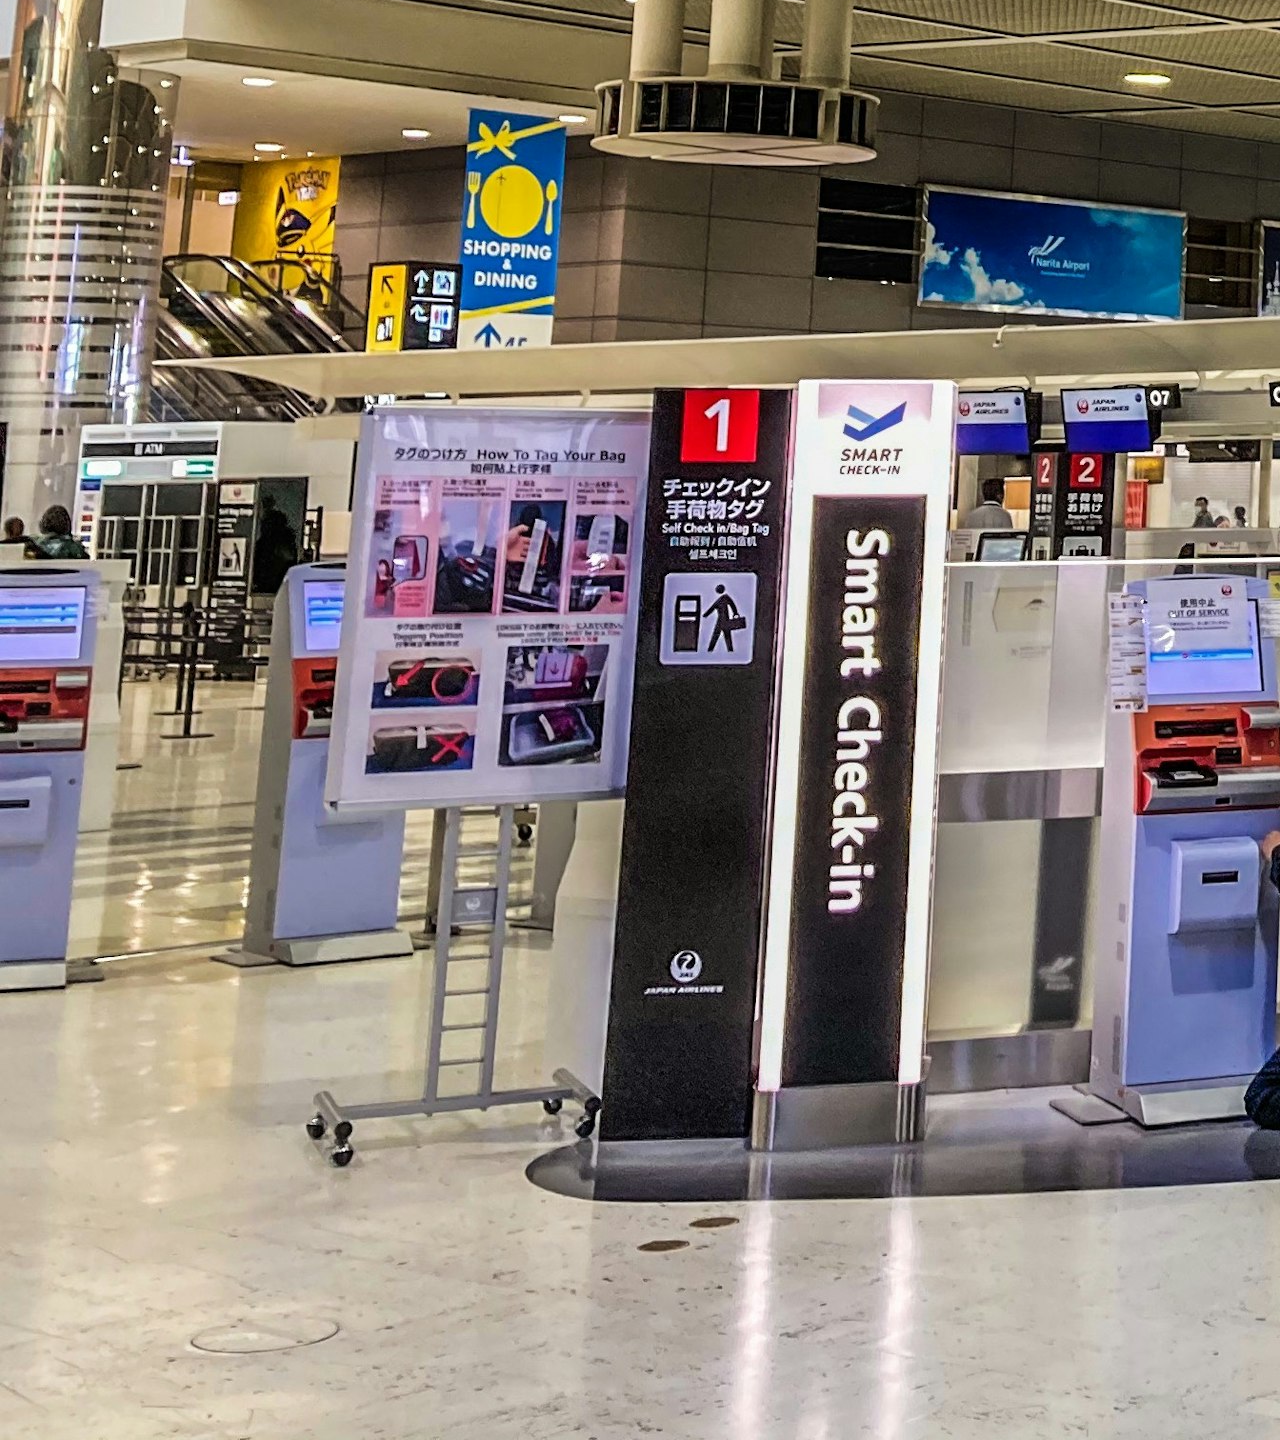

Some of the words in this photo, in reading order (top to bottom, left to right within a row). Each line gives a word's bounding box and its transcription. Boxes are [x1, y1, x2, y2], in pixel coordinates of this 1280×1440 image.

[463, 239, 553, 261] SHOPPING
[502, 258, 512, 271] &
[1036, 257, 1061, 269] Narita
[474, 271, 538, 290] DINING
[1149, 390, 1170, 407] 07
[703, 398, 731, 452] 1
[144, 443, 163, 455] ATM
[477, 449, 508, 461] How
[513, 450, 530, 461] To
[535, 450, 559, 463] Tag
[563, 450, 596, 461] Your
[600, 450, 627, 464] Bag
[840, 448, 904, 463] SMART
[838, 465, 901, 476] CHECK-IN
[1078, 457, 1096, 483] 2
[663, 477, 772, 498] チェックイン
[665, 499, 765, 521] 手荷物タグ
[661, 522, 682, 534] Self
[683, 522, 715, 534] Check
[751, 522, 770, 537] Tag
[839, 528, 890, 678] Smart
[1198, 608, 1230, 617] SERVICE
[826, 695, 883, 915] Check-in
[643, 986, 676, 995] JAPAN
[677, 985, 724, 994] AIRLINES
